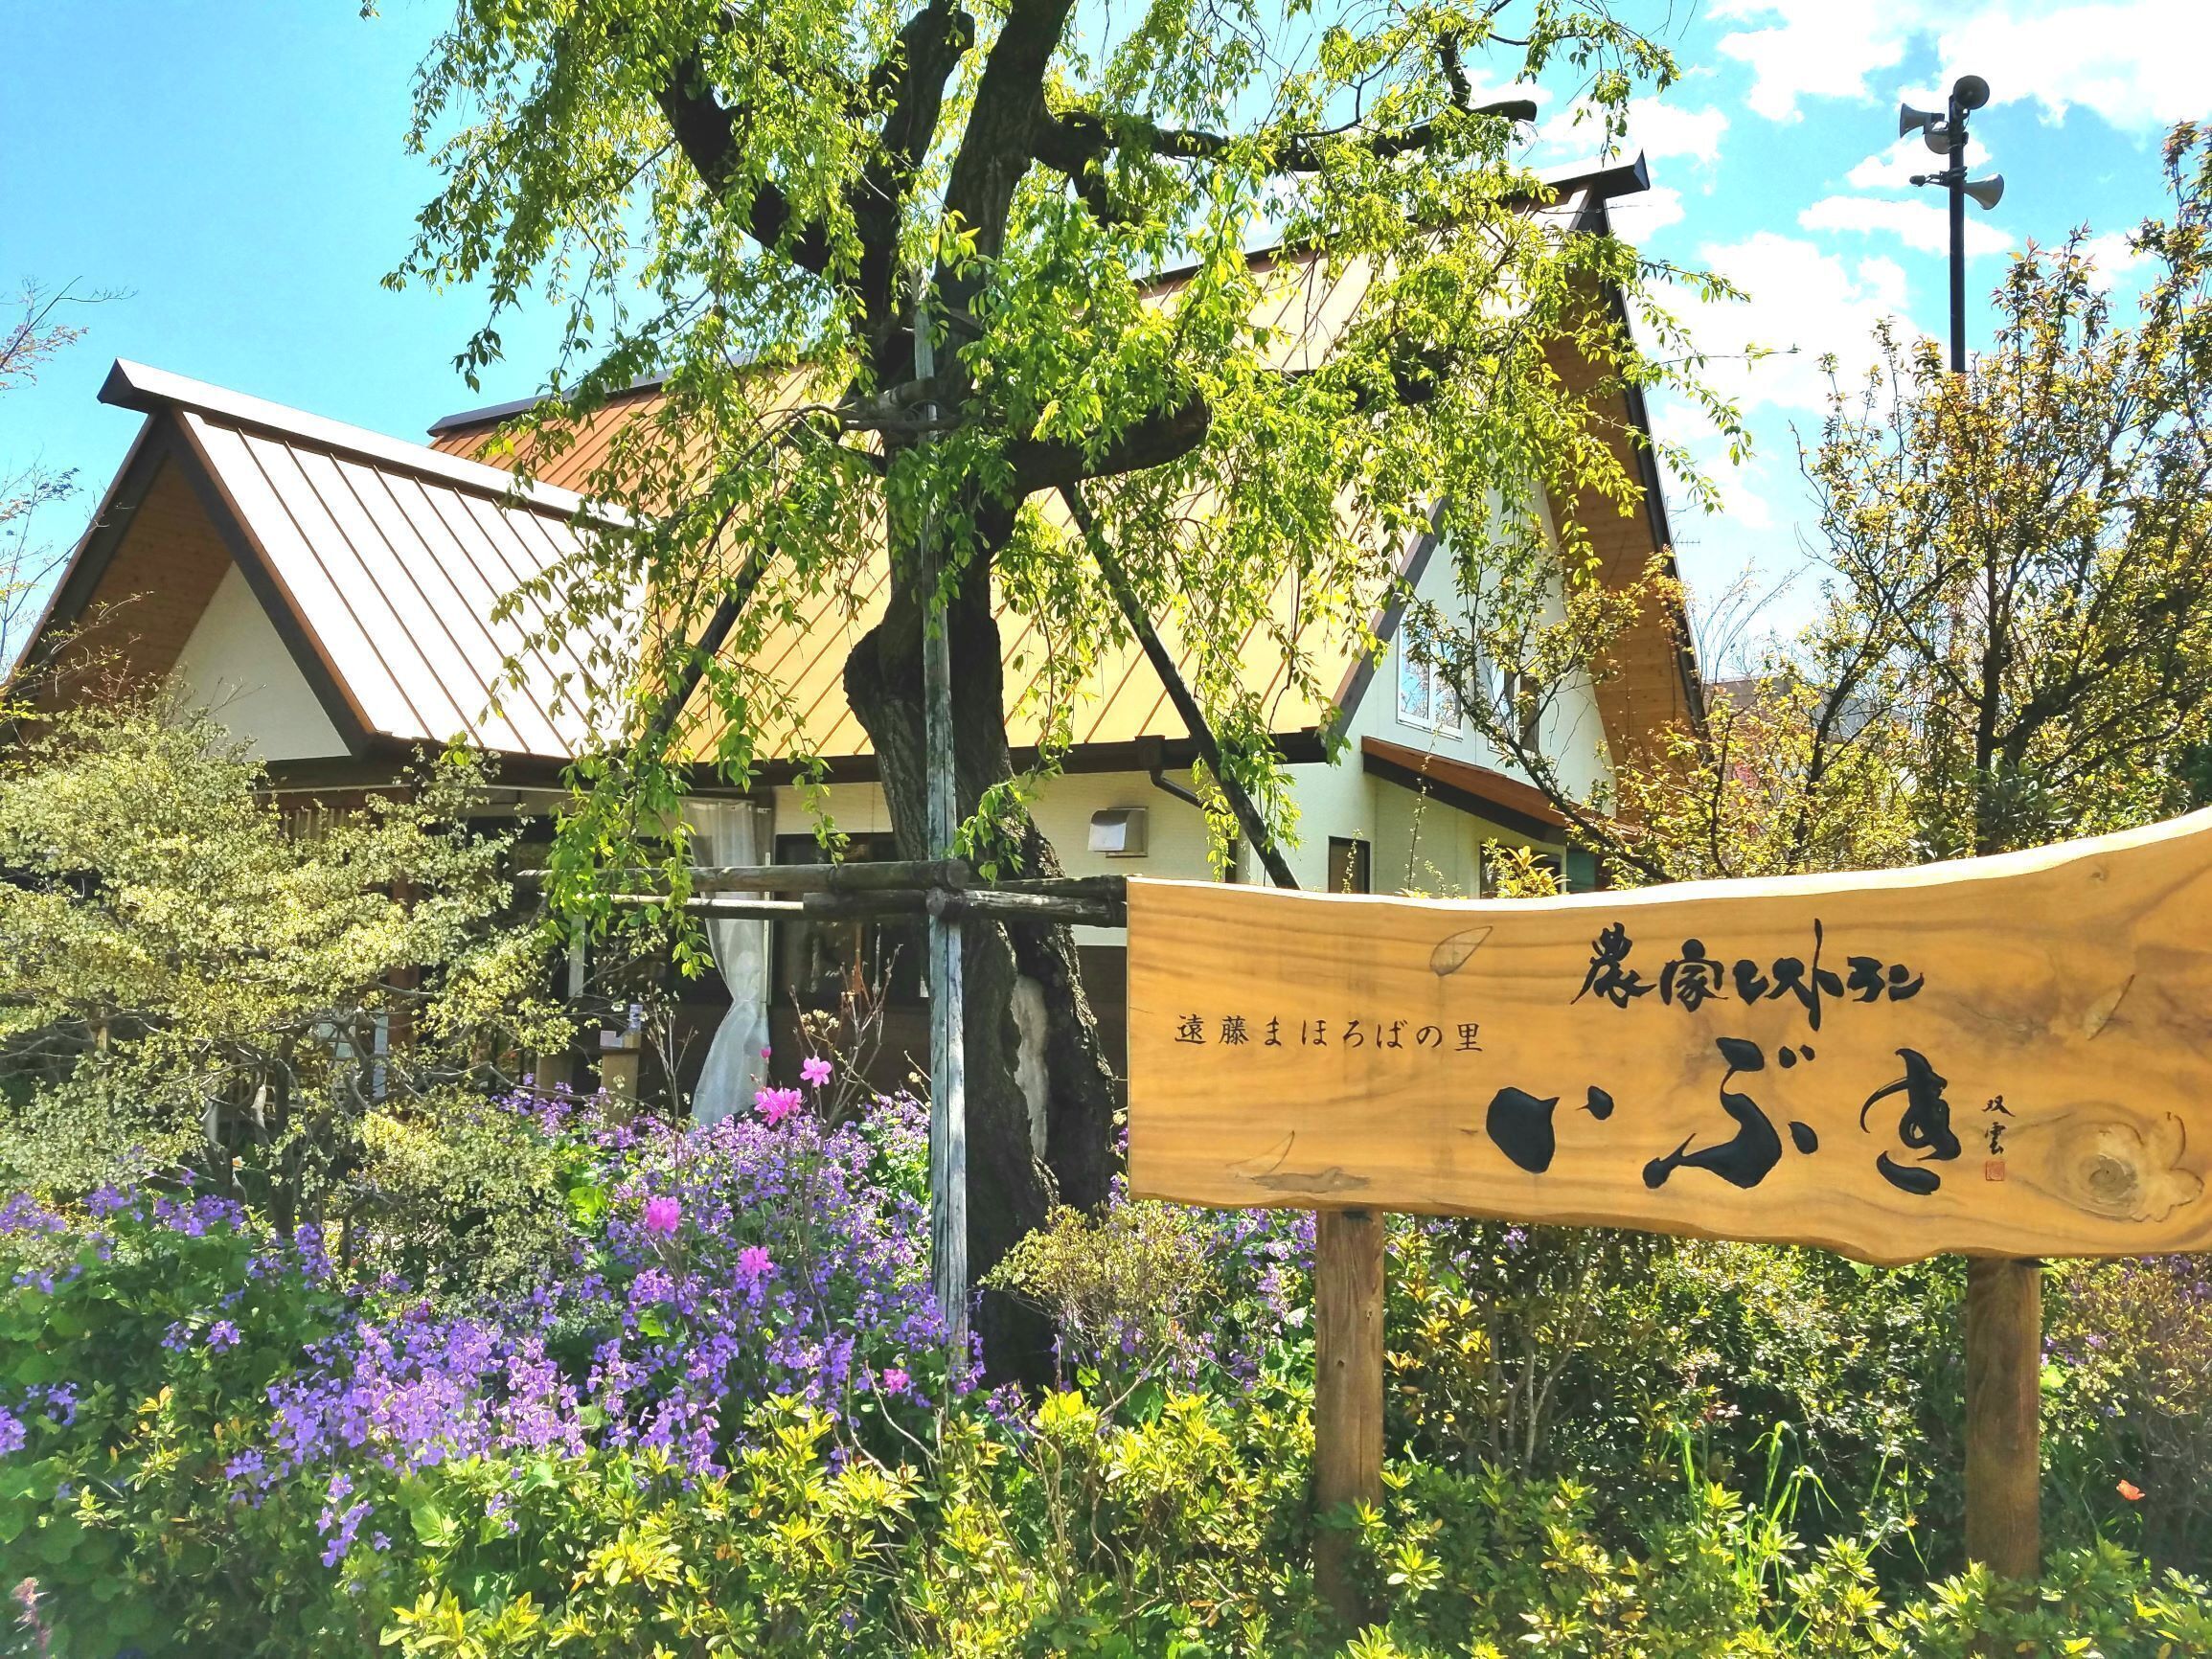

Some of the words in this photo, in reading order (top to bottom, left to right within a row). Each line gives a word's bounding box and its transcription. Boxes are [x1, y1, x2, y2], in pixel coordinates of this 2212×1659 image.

[1174, 1012, 1484, 1052] 遠藤まほろばの里
[1569, 917, 1926, 1033] 農家レストラン
[1484, 1035, 1964, 1197] いぶき
